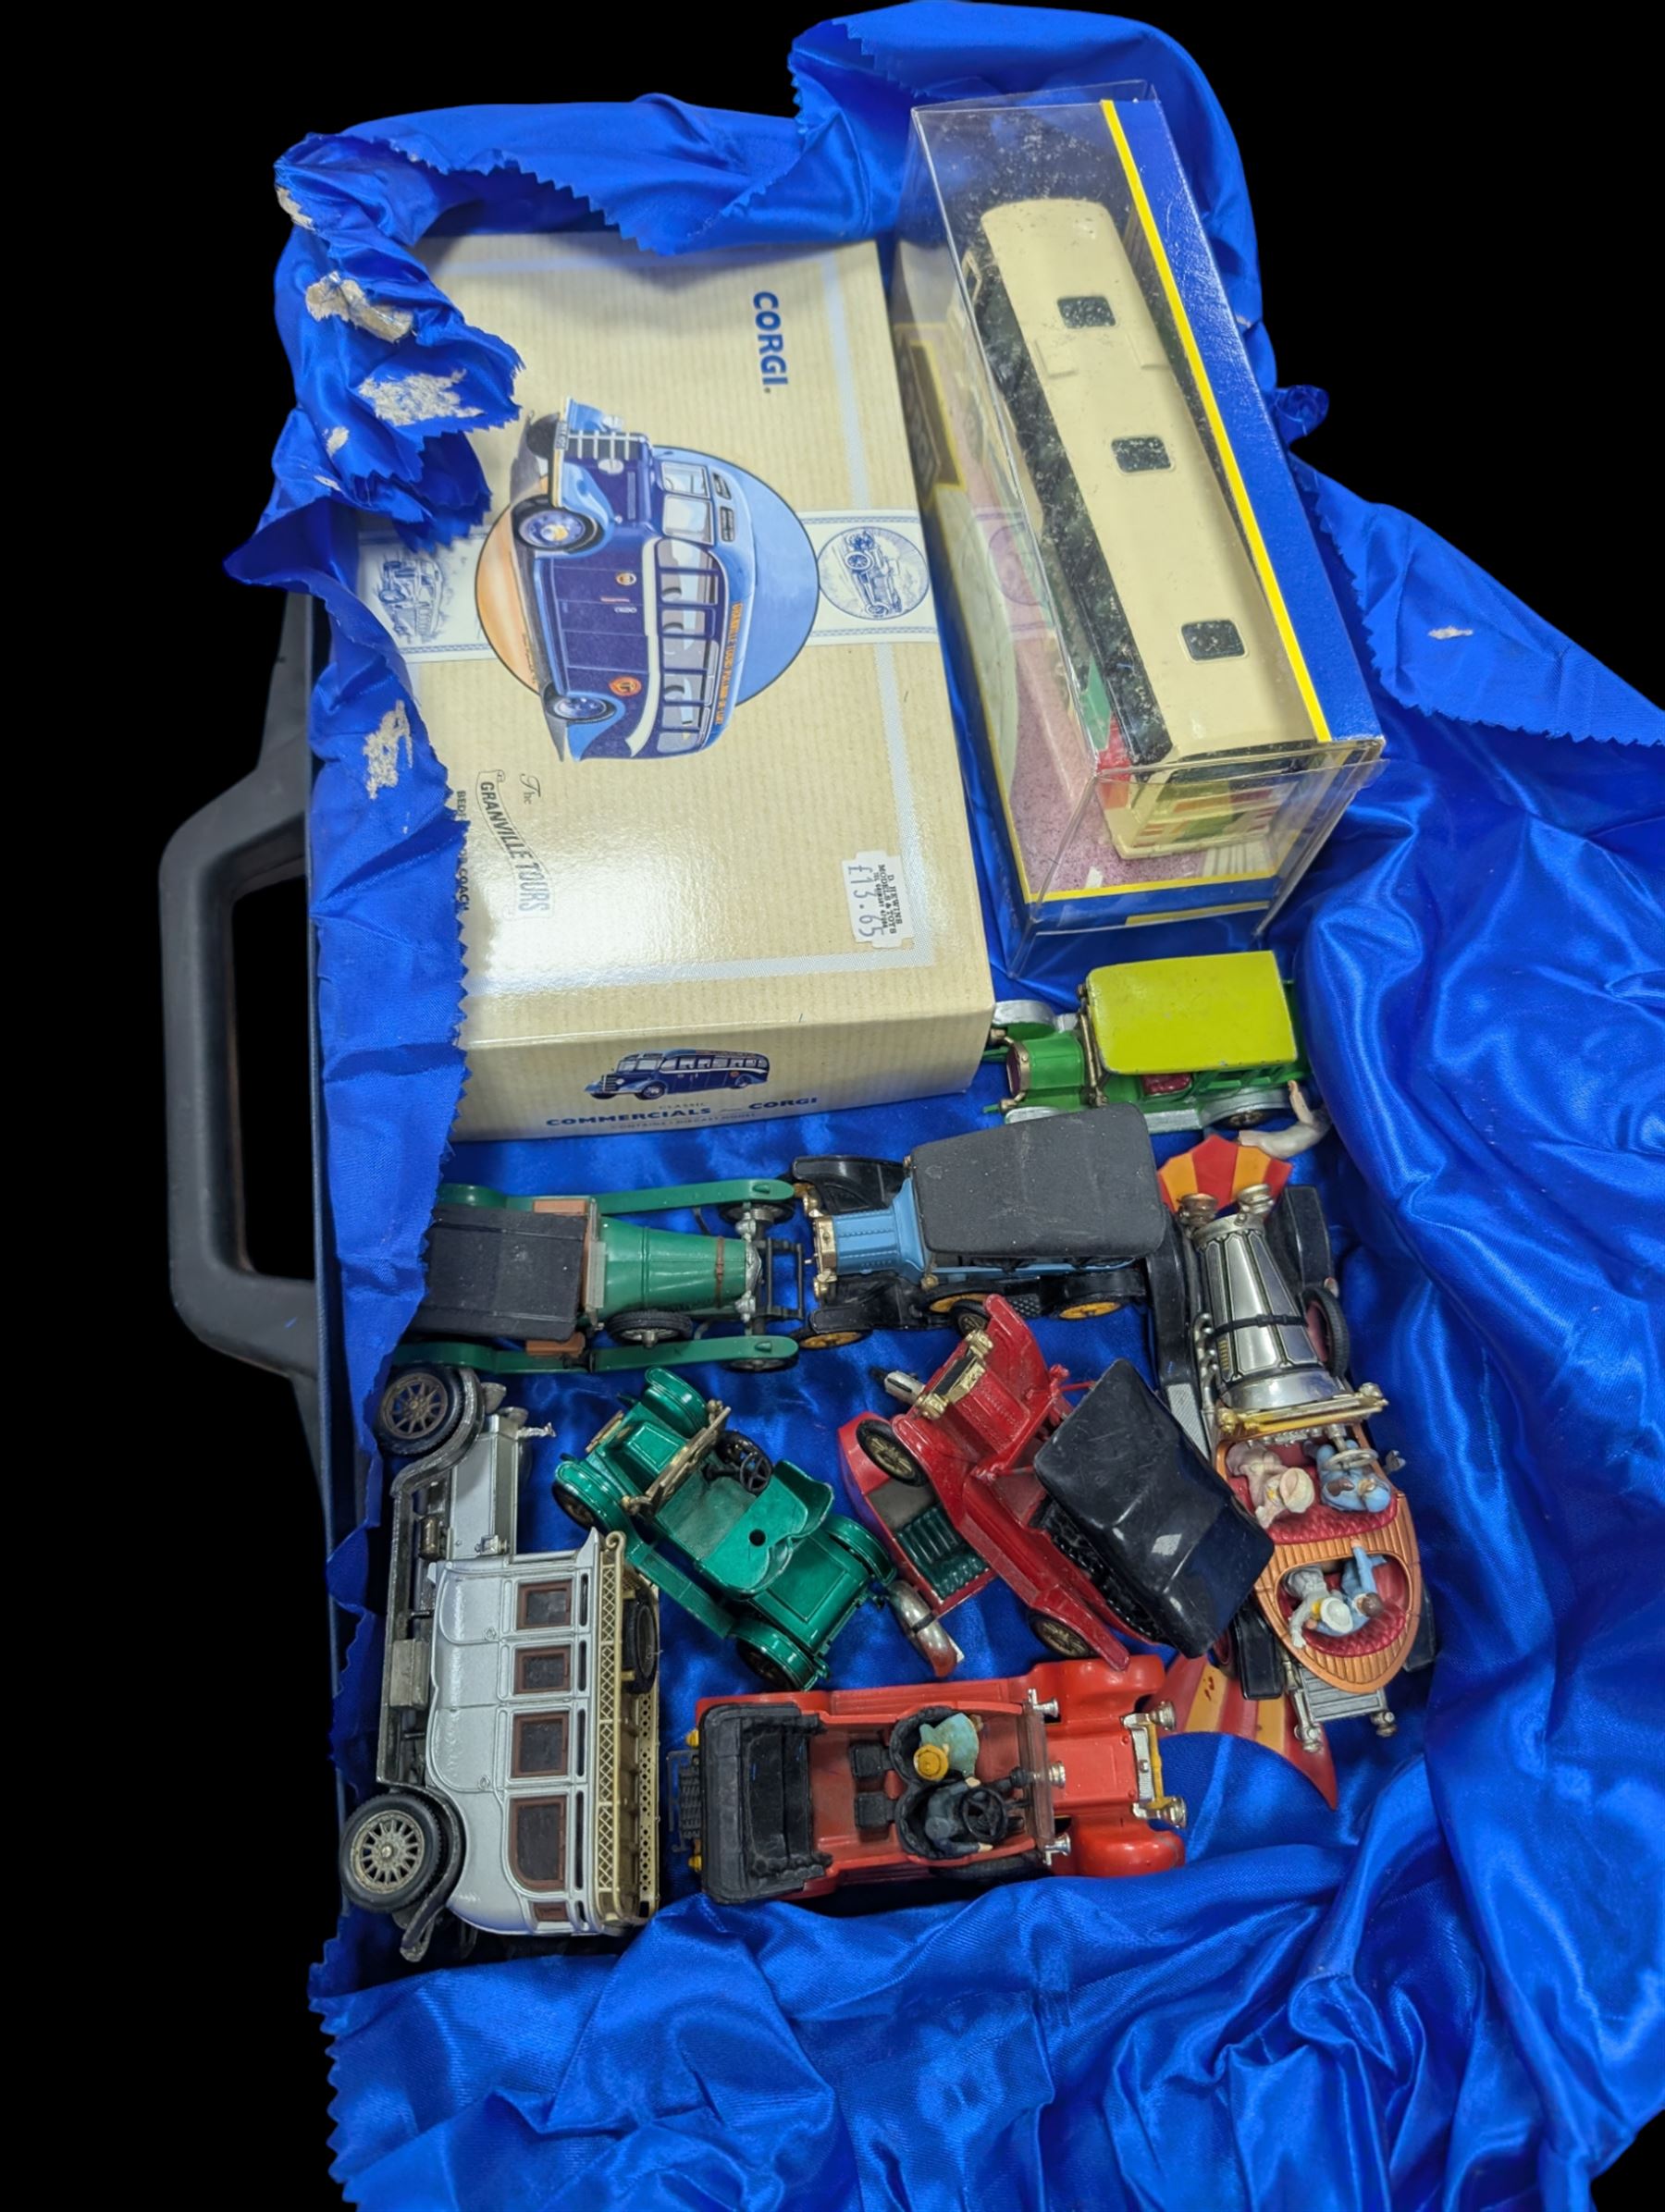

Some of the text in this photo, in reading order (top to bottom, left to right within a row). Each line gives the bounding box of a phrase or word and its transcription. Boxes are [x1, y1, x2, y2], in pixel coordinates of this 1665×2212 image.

[519, 773, 541, 805] The
[480, 781, 550, 912] GRANVILLE TOURS
[878, 865, 891, 902] MODELS
[886, 910, 896, 934] TOYS
[889, 886, 902, 925] HEWINS
[546, 1097, 818, 1126] COMMERCIALS CORGI
